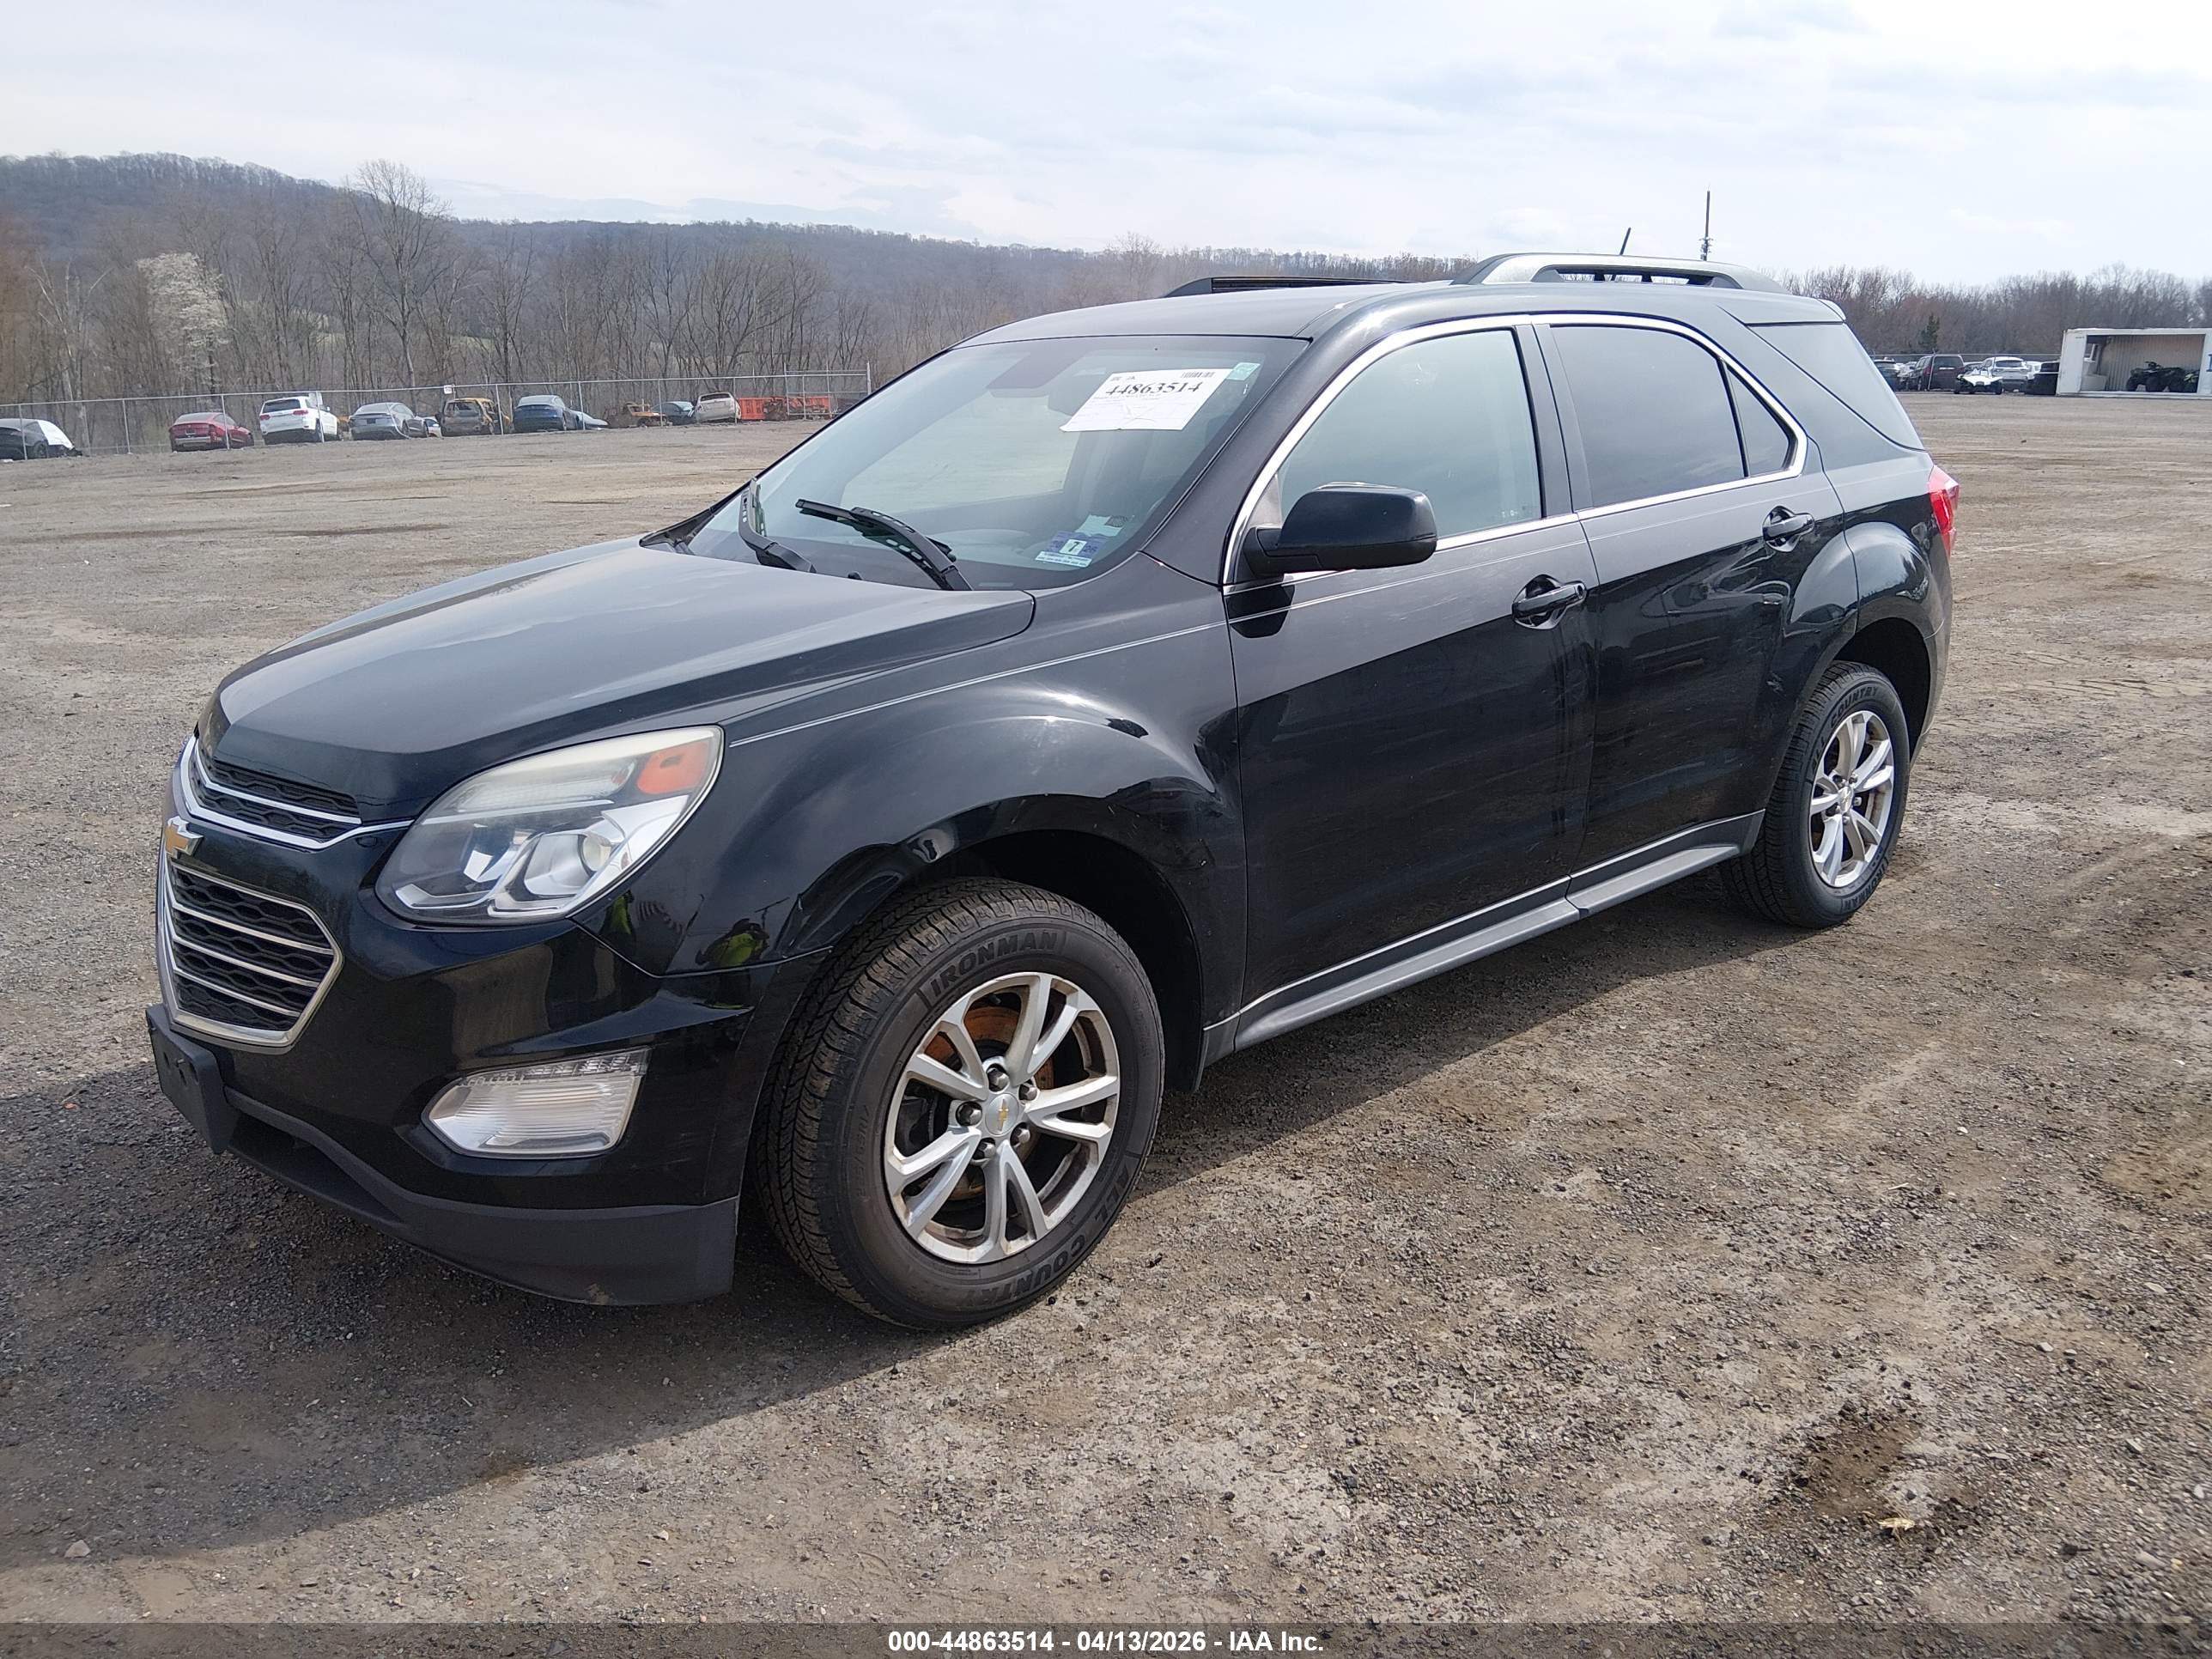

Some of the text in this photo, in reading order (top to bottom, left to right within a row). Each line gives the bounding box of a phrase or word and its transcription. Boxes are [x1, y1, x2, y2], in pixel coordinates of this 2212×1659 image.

[1106, 382, 1203, 396] 44863514
[1831, 686, 1879, 728] COUNTRY
[930, 931, 1058, 998] IRONMAN
[965, 1164, 1130, 1305] ALL COUNTRY
